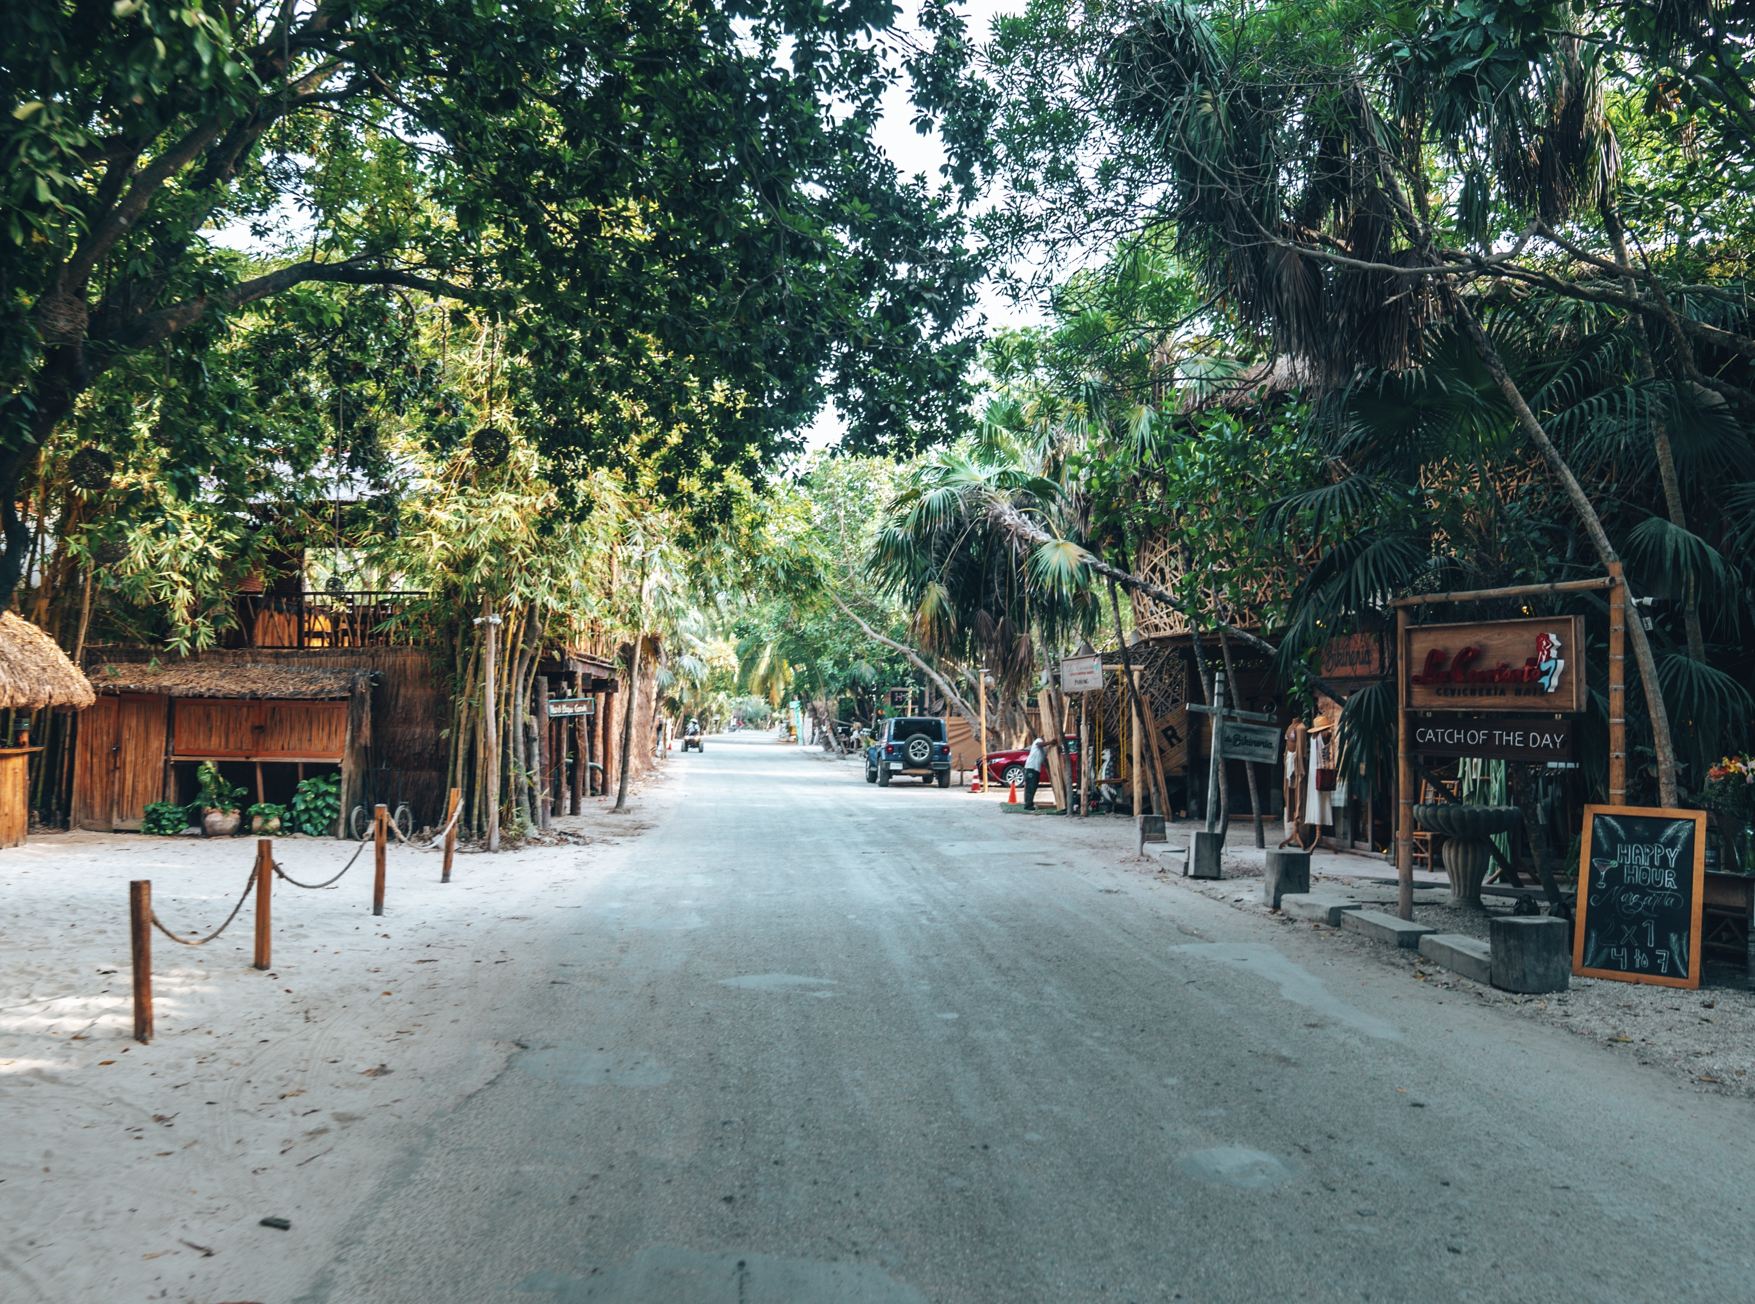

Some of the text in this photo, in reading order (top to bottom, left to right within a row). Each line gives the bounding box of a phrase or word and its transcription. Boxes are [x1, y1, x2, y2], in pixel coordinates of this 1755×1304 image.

[1415, 727, 1565, 749] CATCH OF THE DAY
[1617, 843, 1679, 868] HAPPY
[1624, 865, 1678, 889] HOUR
[1611, 947, 1670, 974] 4 to 7
